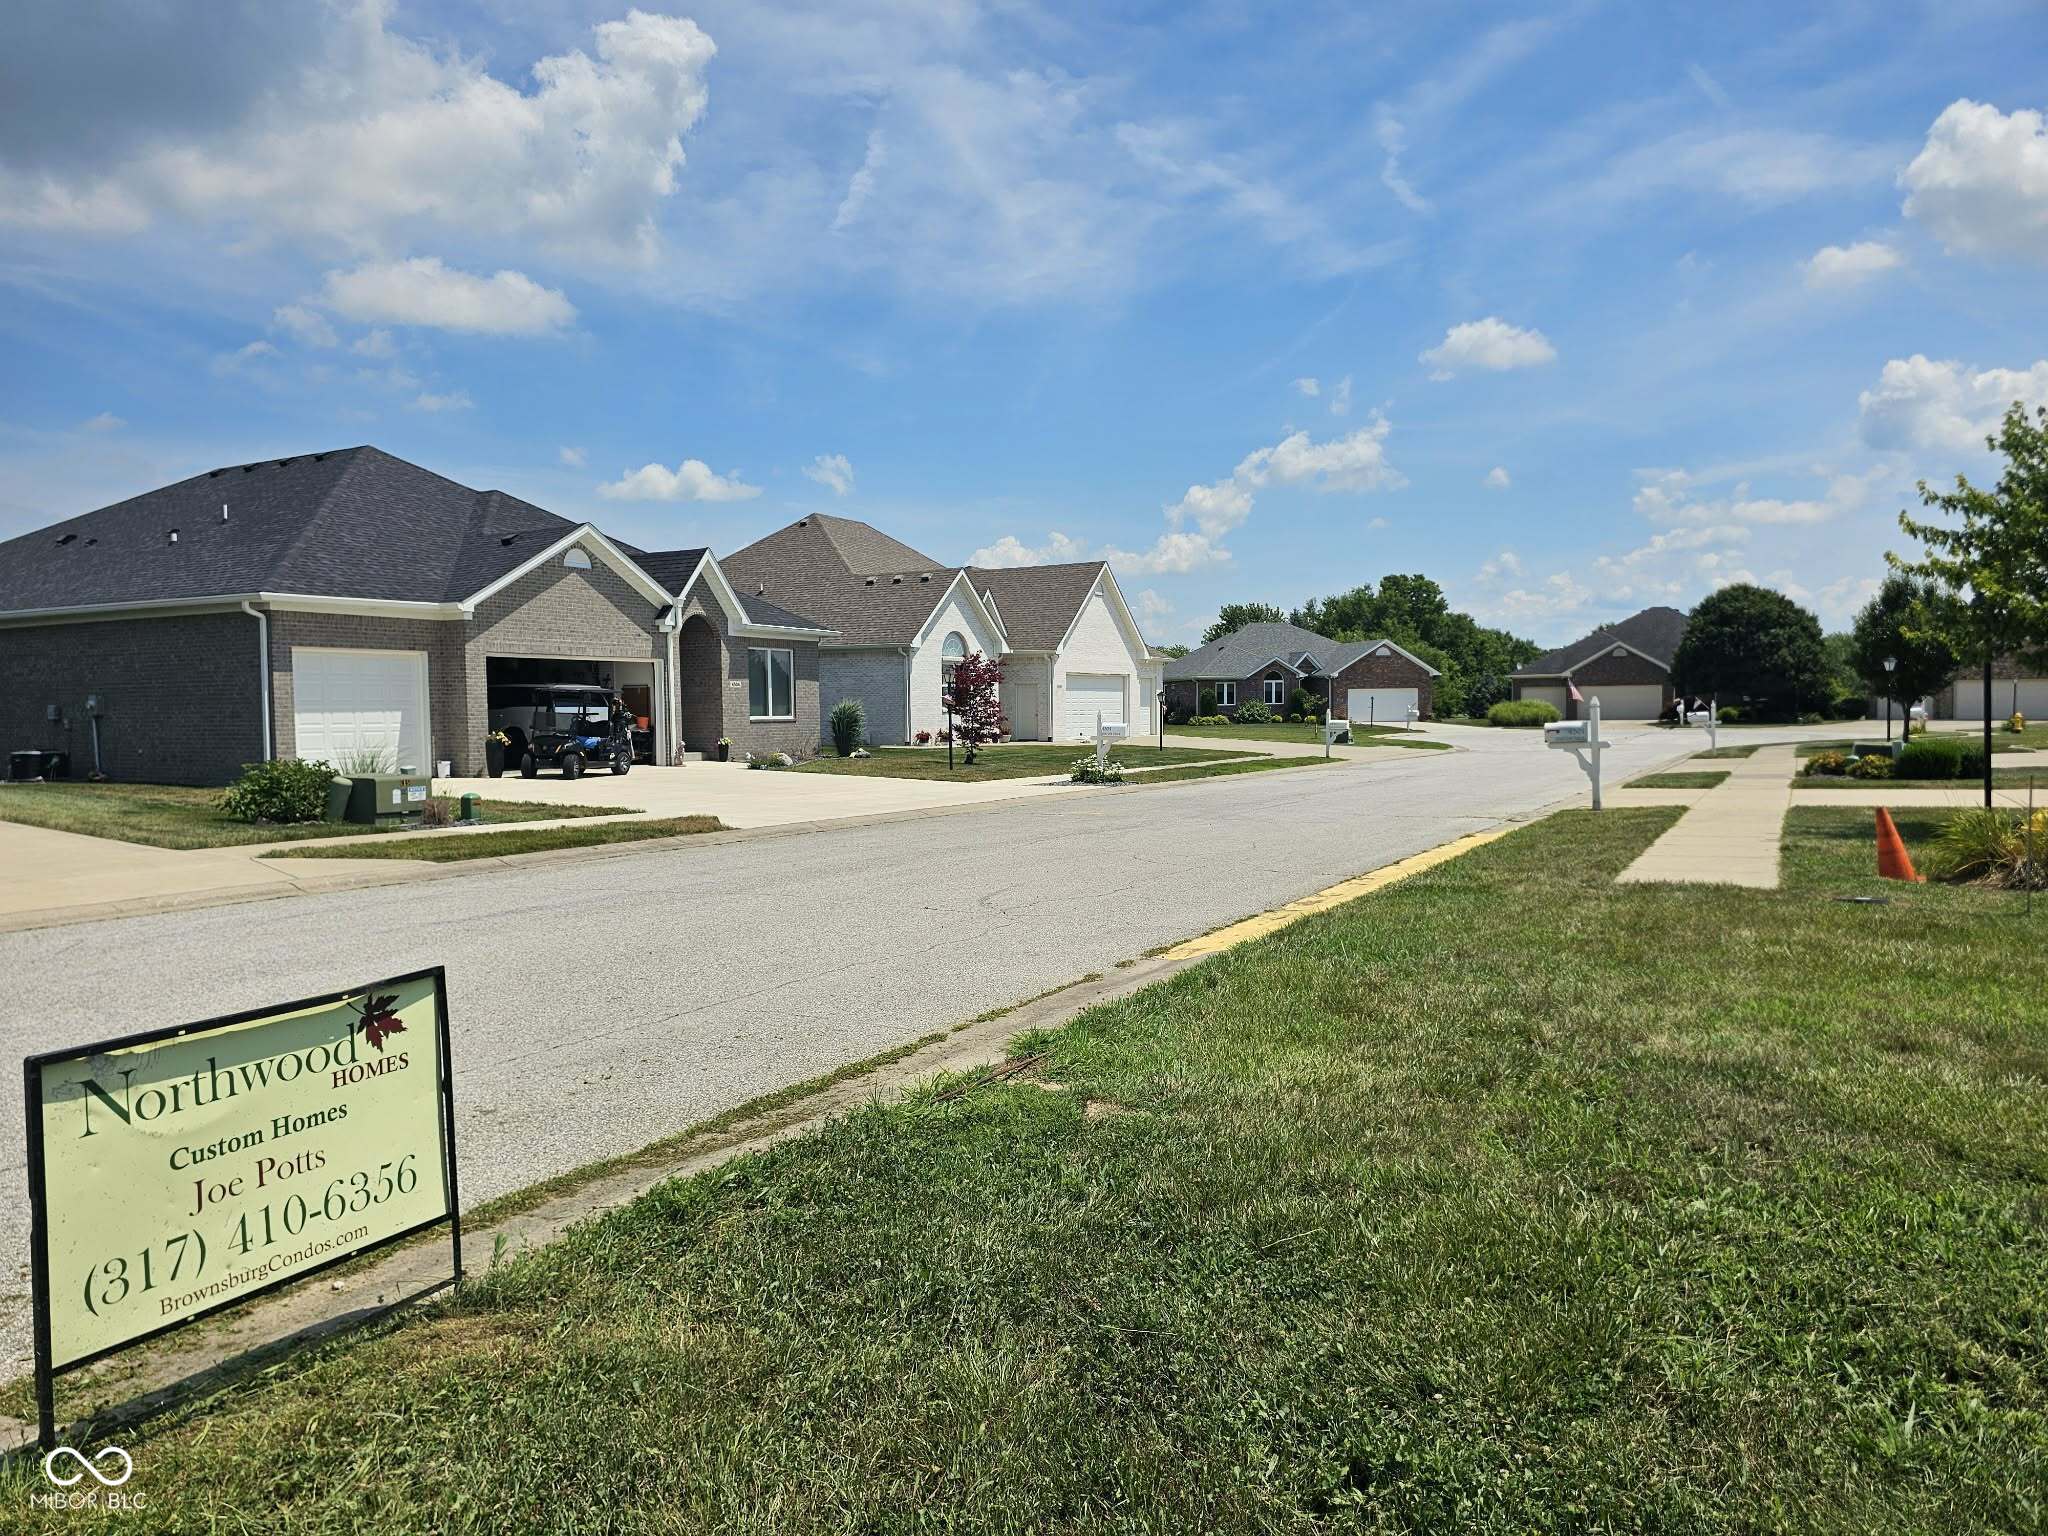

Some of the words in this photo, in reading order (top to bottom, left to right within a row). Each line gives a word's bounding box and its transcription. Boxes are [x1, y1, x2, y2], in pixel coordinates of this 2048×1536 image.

[75, 1023, 359, 1138] Northwood
[331, 1052, 409, 1089] HOMES
[169, 1129, 264, 1171] Custom
[271, 1103, 348, 1140] Homes
[189, 1177, 245, 1217] Joe
[255, 1149, 326, 1189] Potts
[83, 1228, 206, 1317] (317)
[227, 1154, 417, 1256] 410-6356
[160, 1225, 369, 1316] BrownsburgCondos.com
